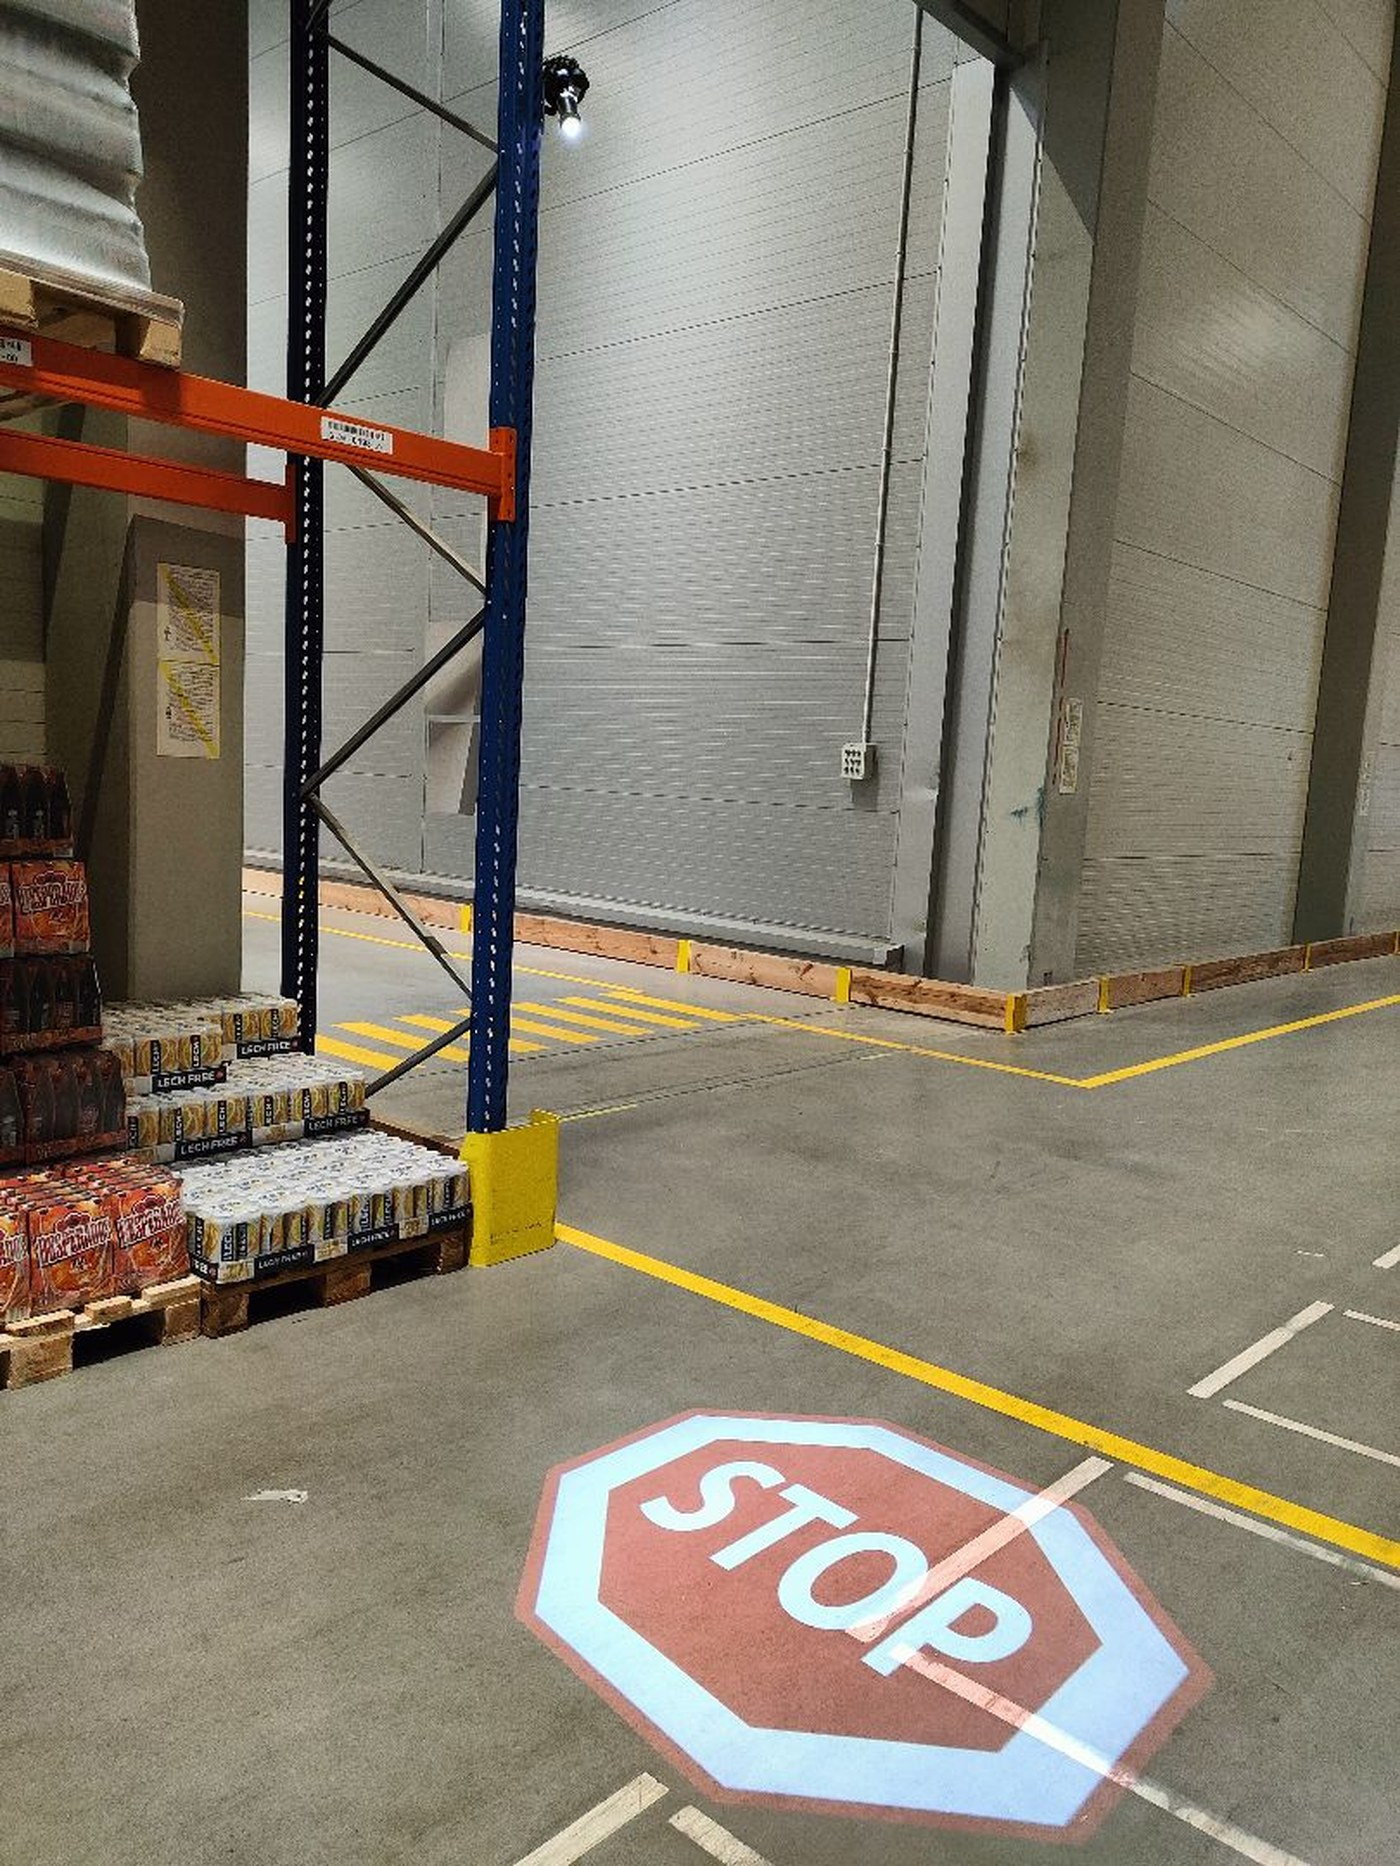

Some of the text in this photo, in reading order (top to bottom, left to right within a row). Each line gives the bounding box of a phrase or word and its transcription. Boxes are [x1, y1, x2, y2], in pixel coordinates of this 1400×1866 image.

[158, 1076, 186, 1088] LECH
[181, 1141, 209, 1155] LECH
[640, 1461, 1033, 1677] STOP
